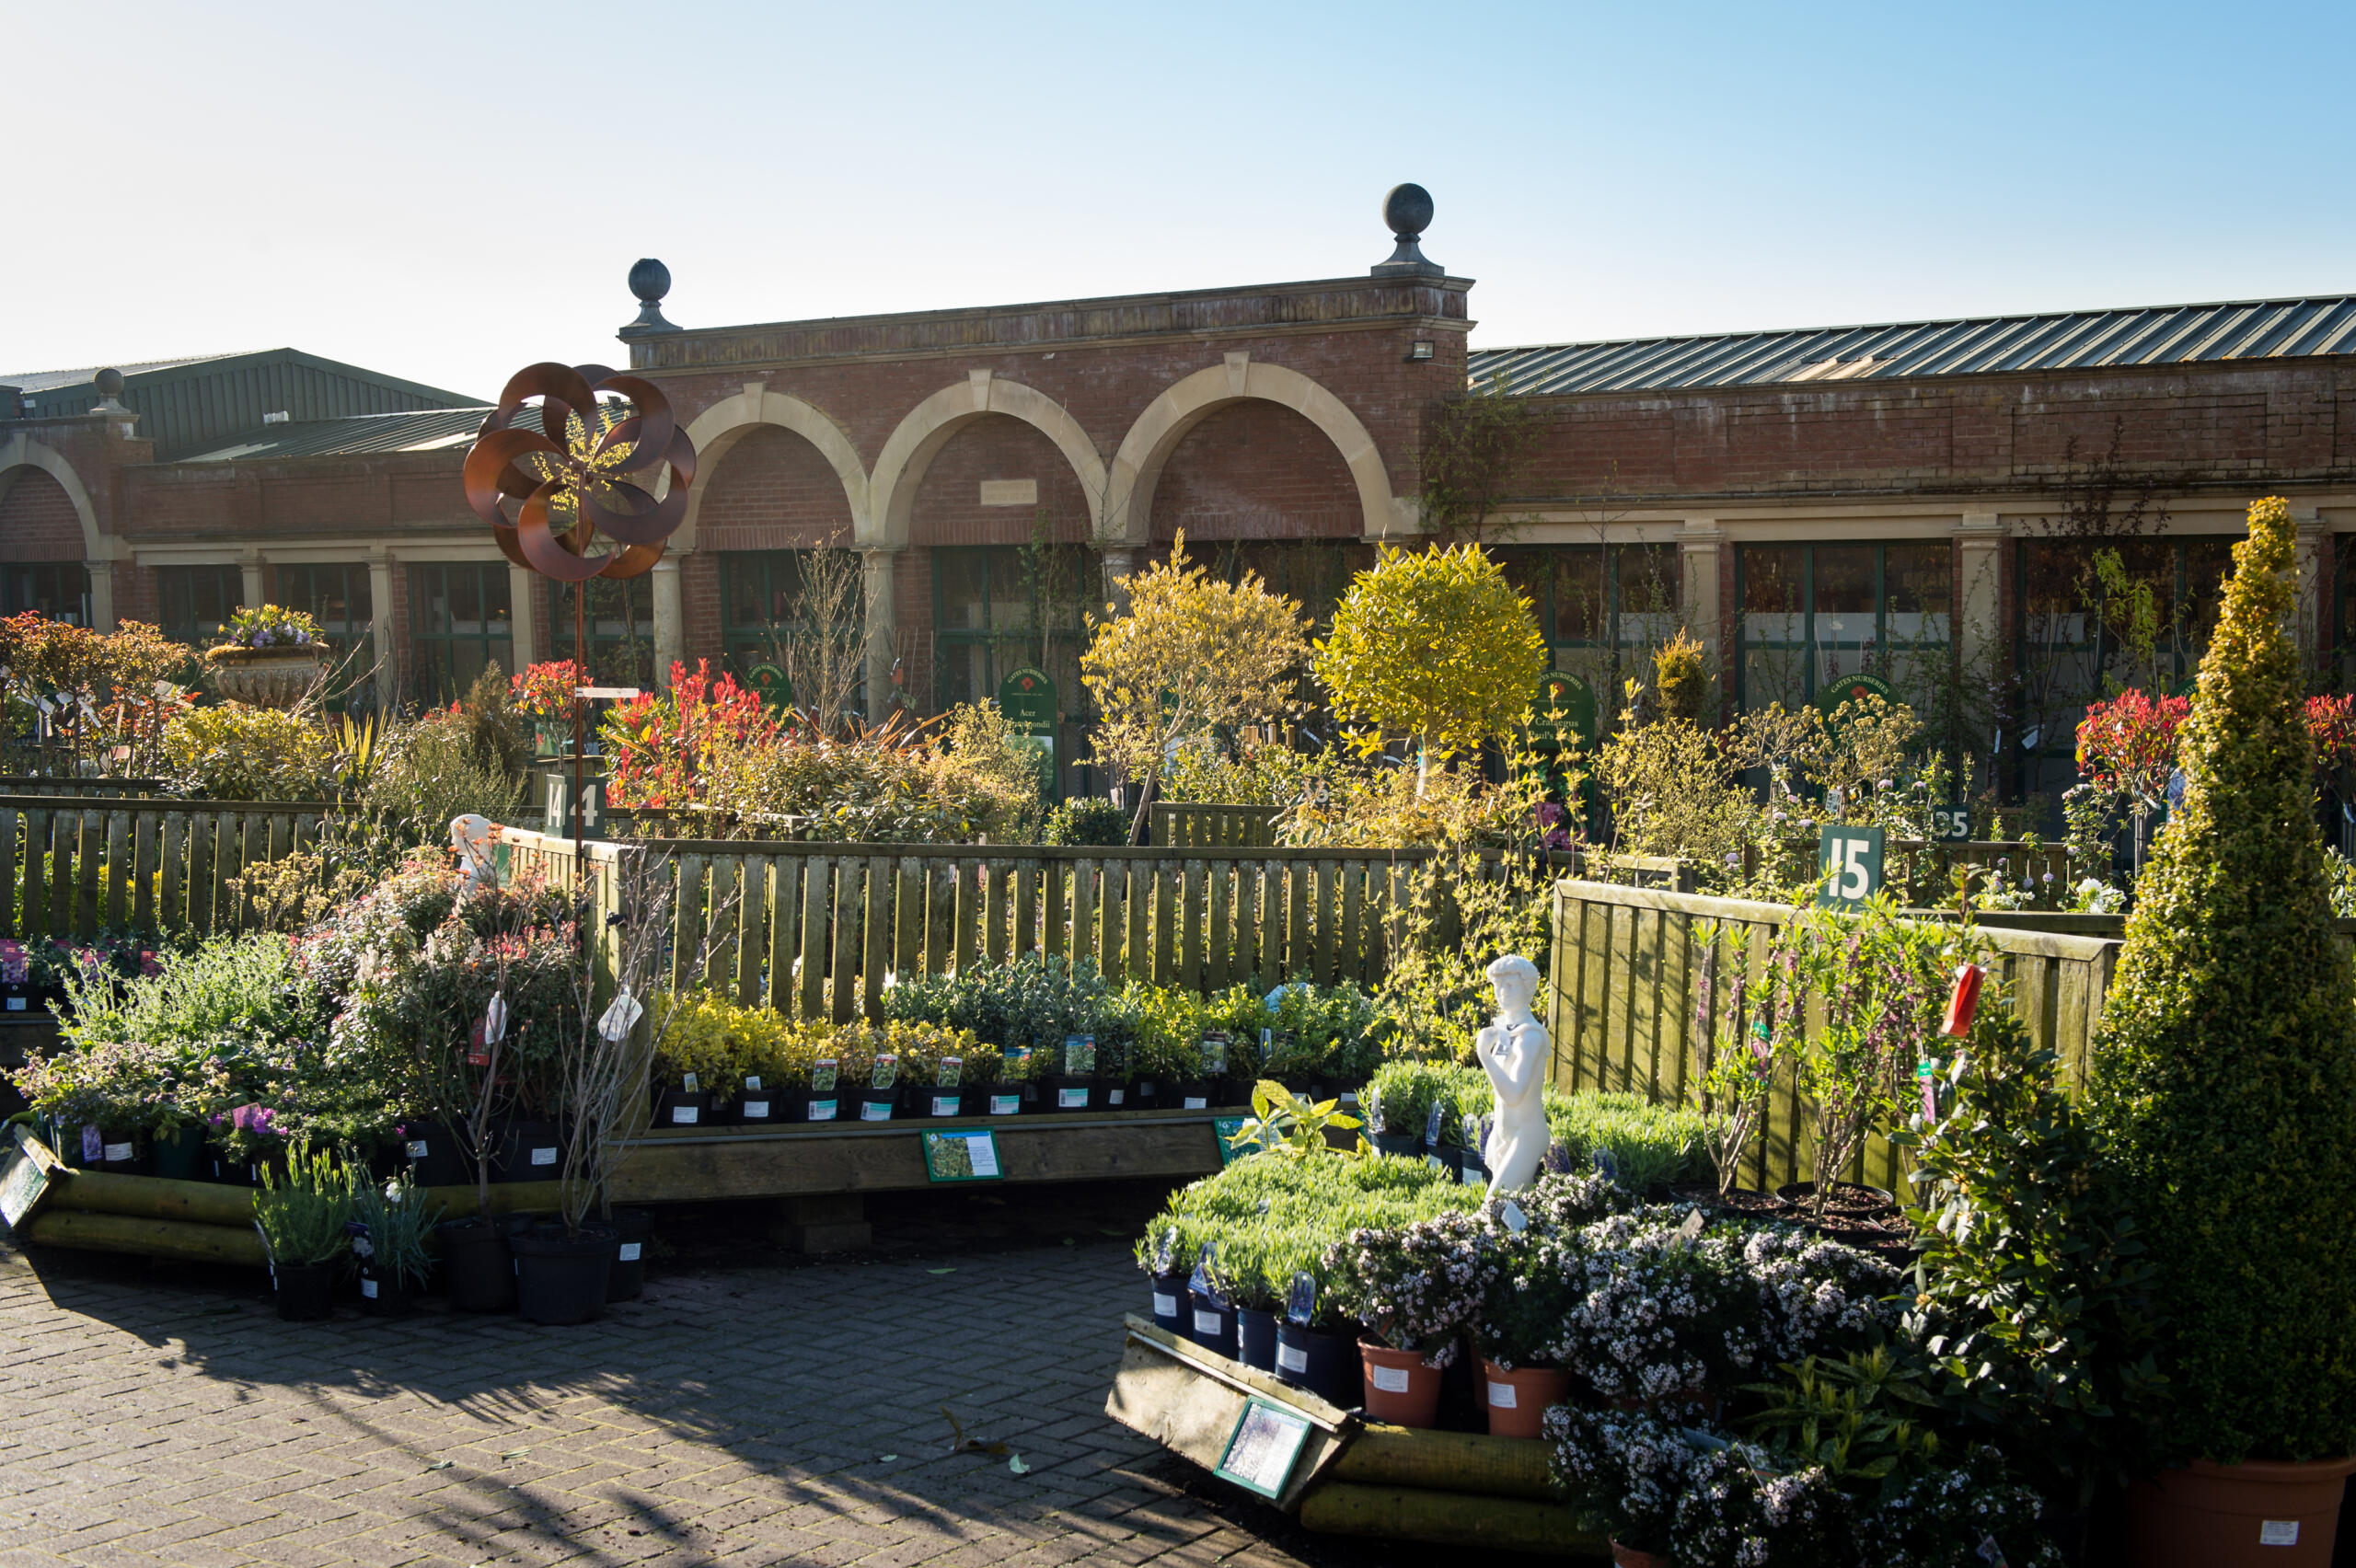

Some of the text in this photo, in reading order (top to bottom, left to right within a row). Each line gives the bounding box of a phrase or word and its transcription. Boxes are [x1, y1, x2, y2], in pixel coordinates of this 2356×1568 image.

[1550, 671, 1584, 691] NURSERIES
[1831, 674, 1889, 695] GATES NURSERIES
[1020, 709, 1036, 717] Acer
[548, 783, 562, 828] 14
[1935, 811, 1969, 837] 35
[1828, 837, 1870, 900] 15
